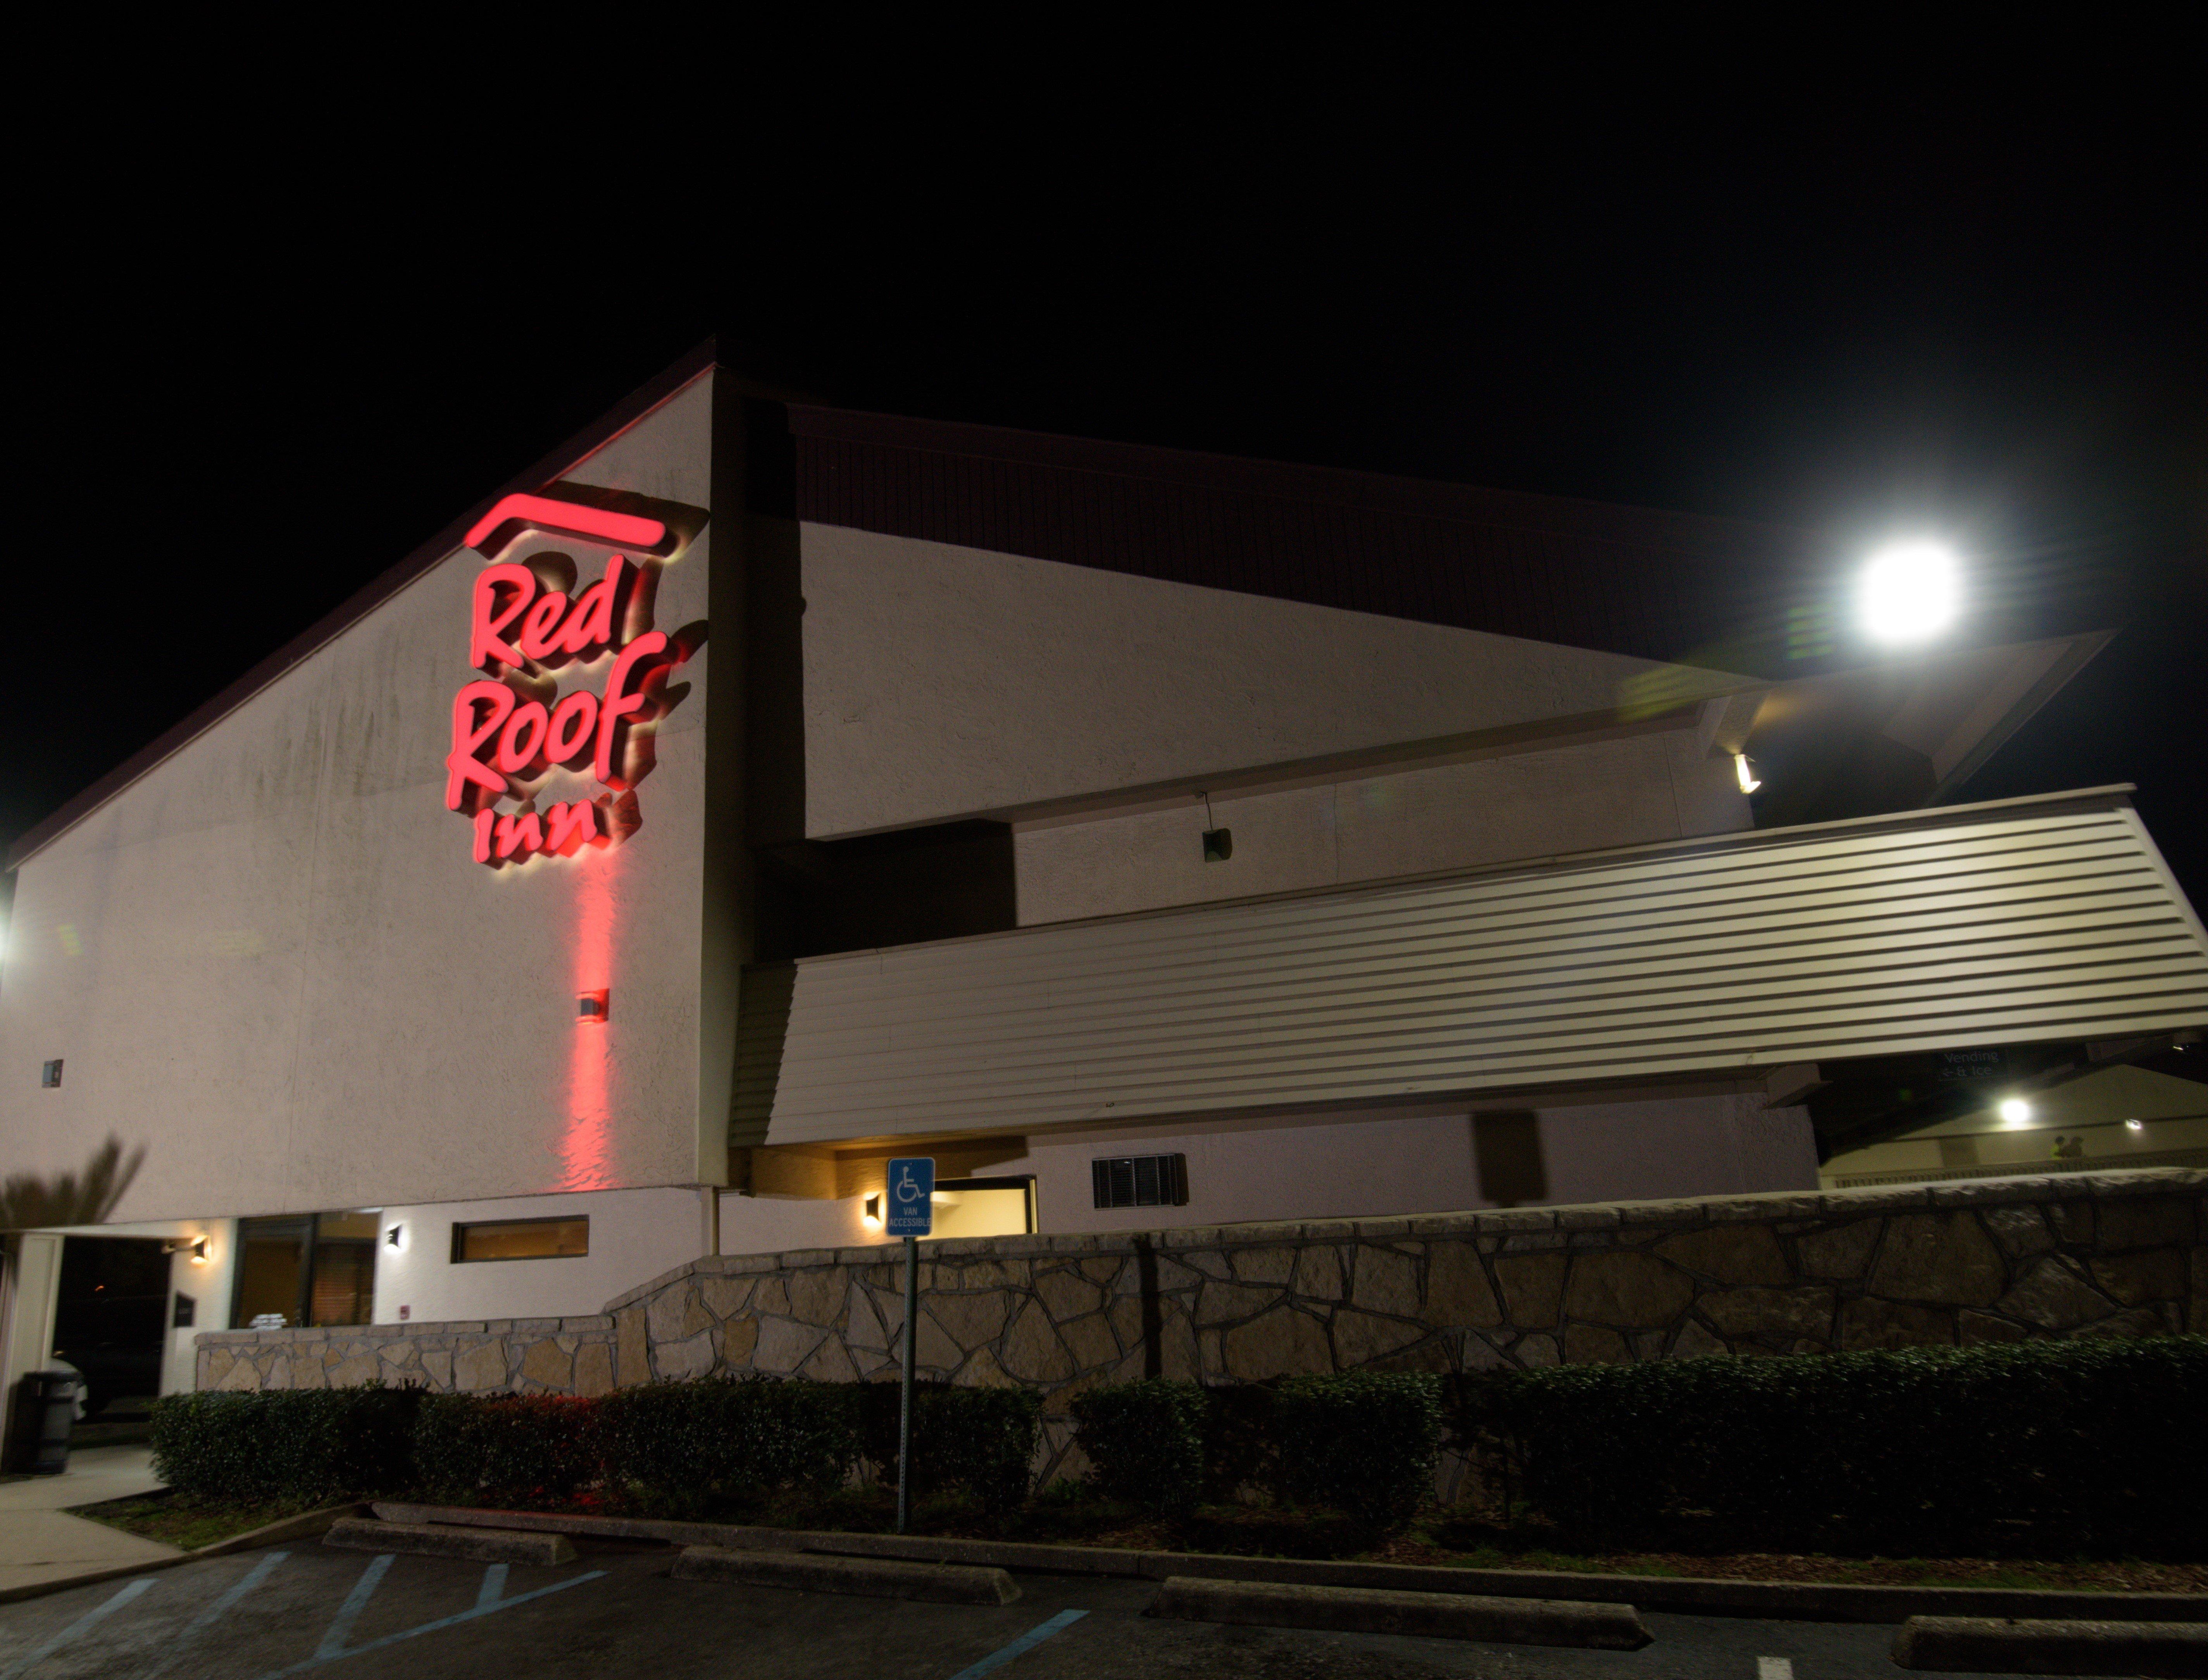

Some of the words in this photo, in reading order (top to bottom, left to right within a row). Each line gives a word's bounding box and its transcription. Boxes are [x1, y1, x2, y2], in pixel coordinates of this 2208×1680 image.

[472, 553, 624, 669] Red
[447, 631, 667, 810] Roof
[1944, 1051, 1999, 1063] Vending
[1956, 1066, 1967, 1077] &
[1972, 1065, 1992, 1076] Ice
[903, 1207, 917, 1215] VAN
[889, 1218, 931, 1227] ACCESSIBLE
